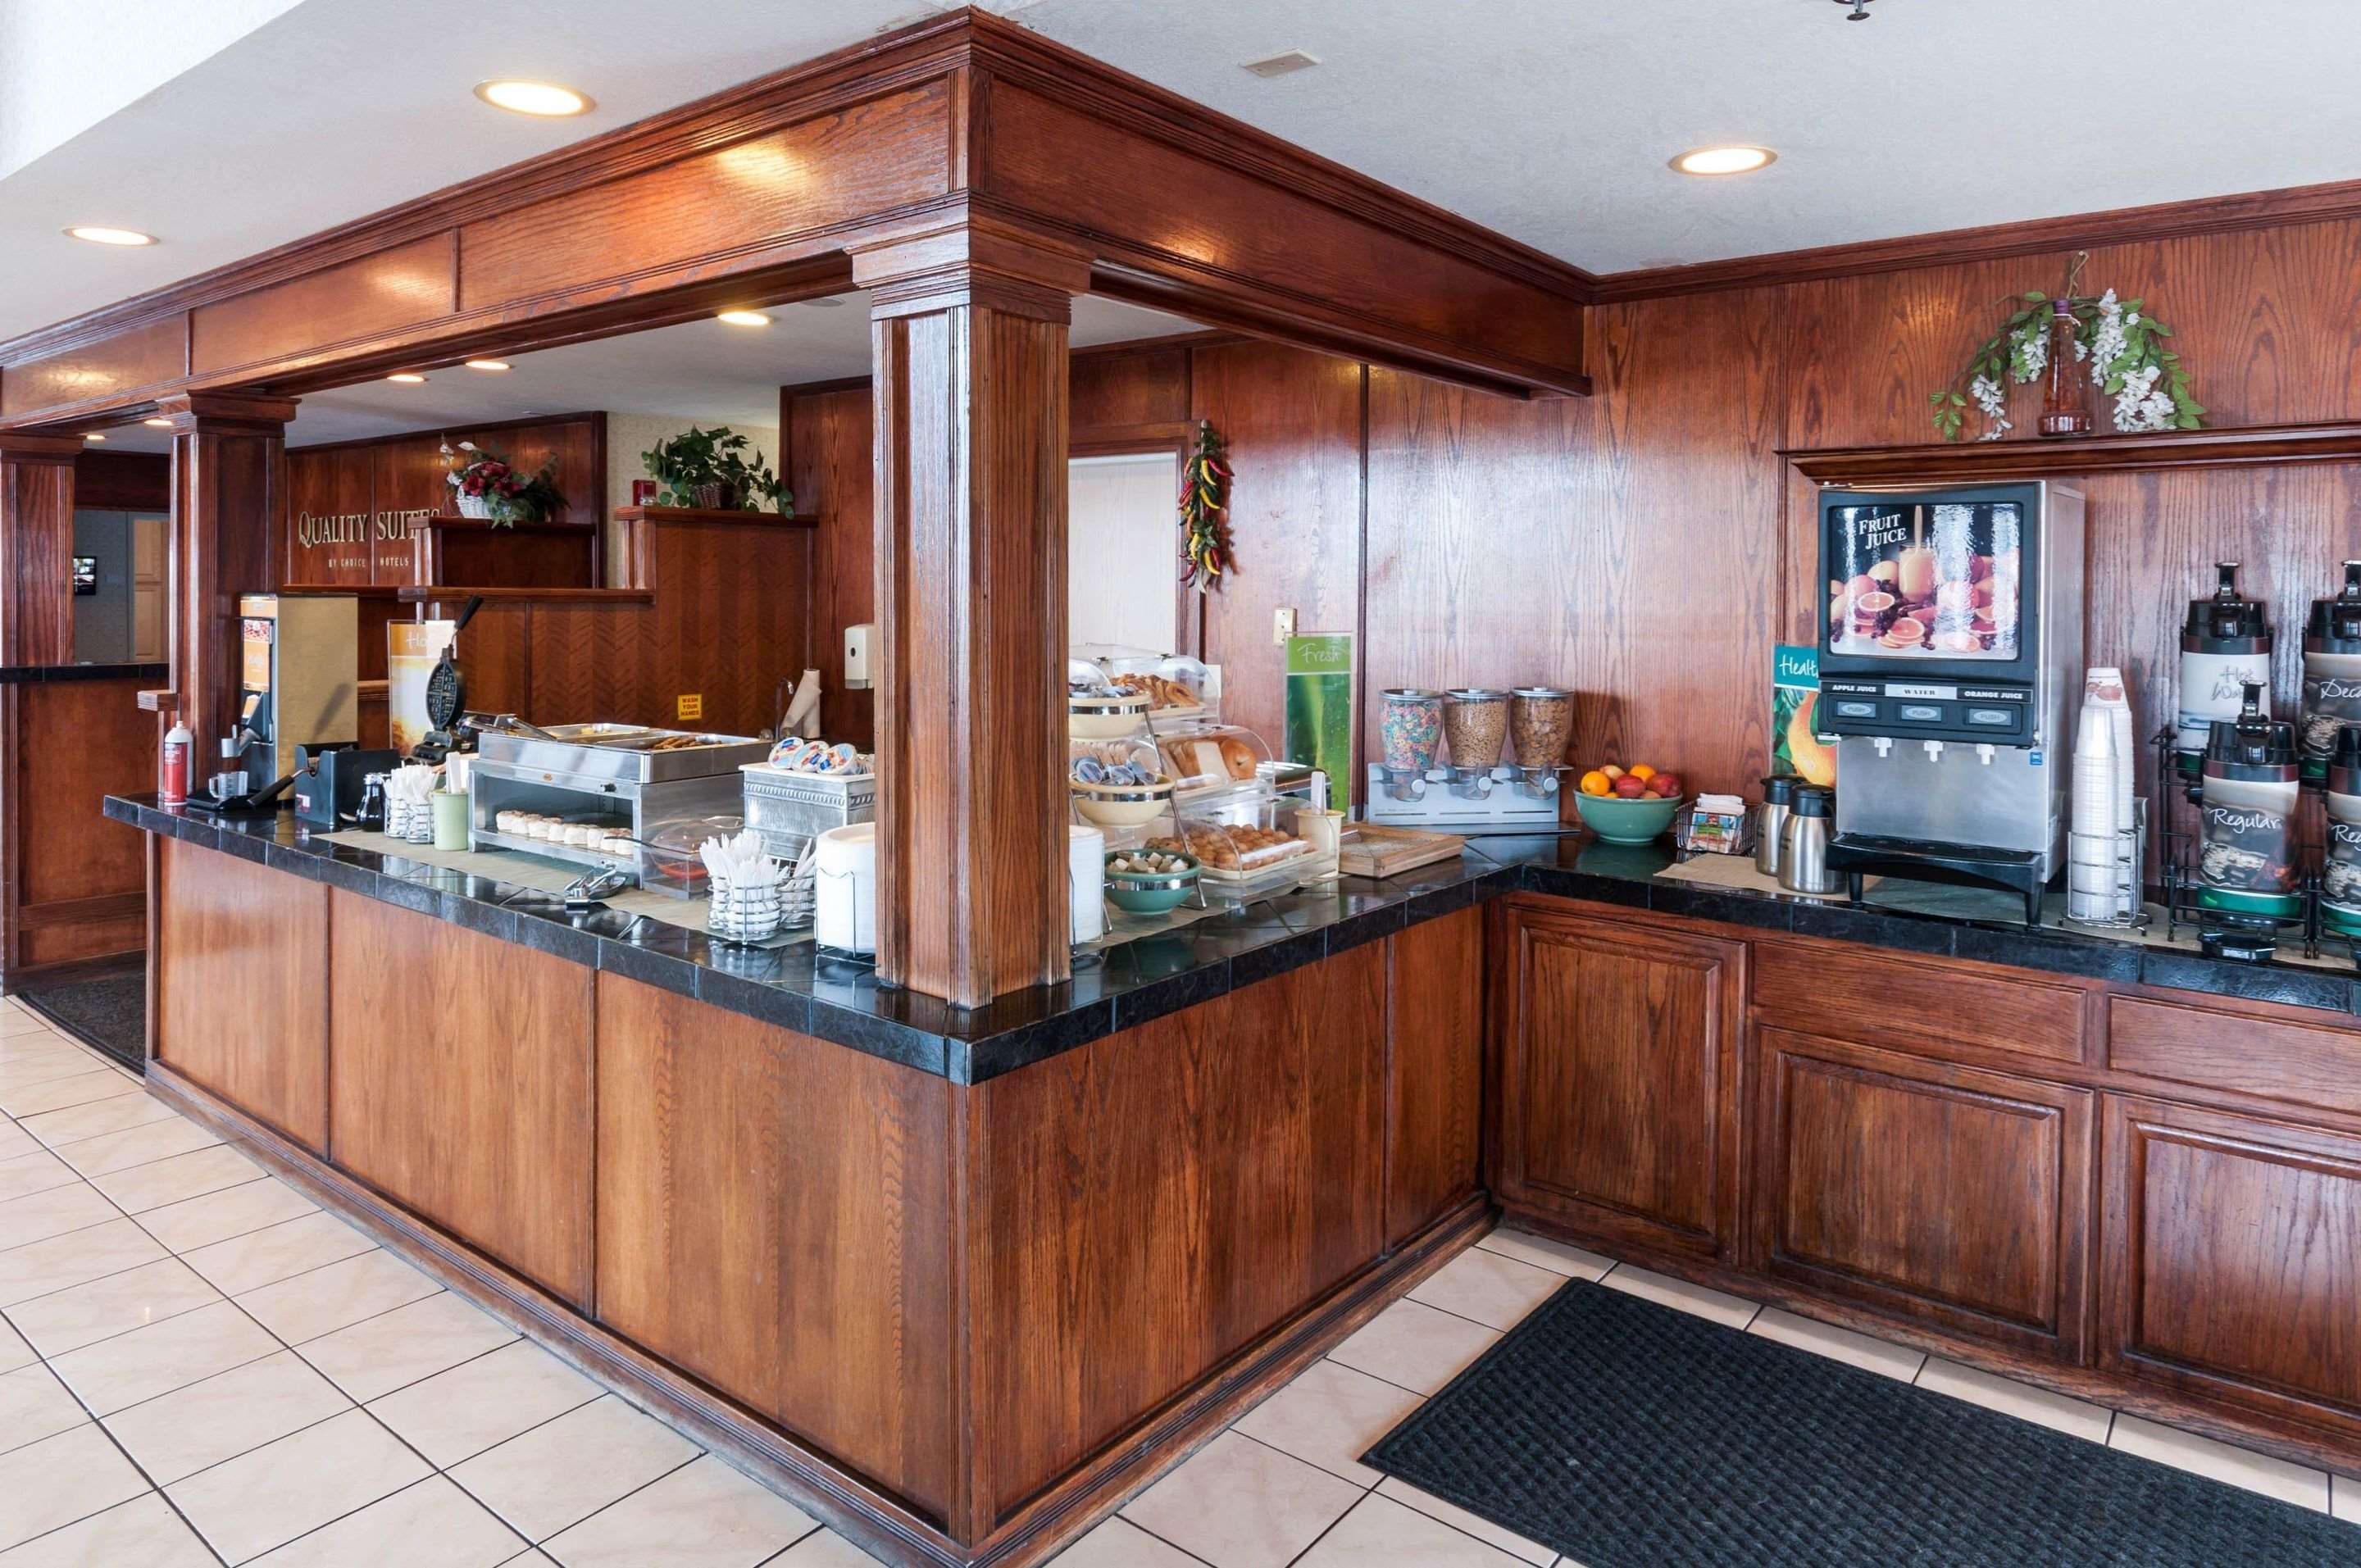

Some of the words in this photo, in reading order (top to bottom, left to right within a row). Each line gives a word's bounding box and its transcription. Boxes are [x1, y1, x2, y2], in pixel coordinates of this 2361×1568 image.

[298, 511, 367, 548] QUALITY
[1858, 513, 1901, 535] FRUIT
[1865, 527, 1908, 550] JUICE
[328, 559, 336, 568] BY
[340, 557, 366, 568] CHOICE
[380, 557, 410, 567] HOTELS
[1297, 643, 1340, 664] Fresh
[1963, 690, 1999, 698] ORANGE
[2209, 808, 2281, 834] Regular
